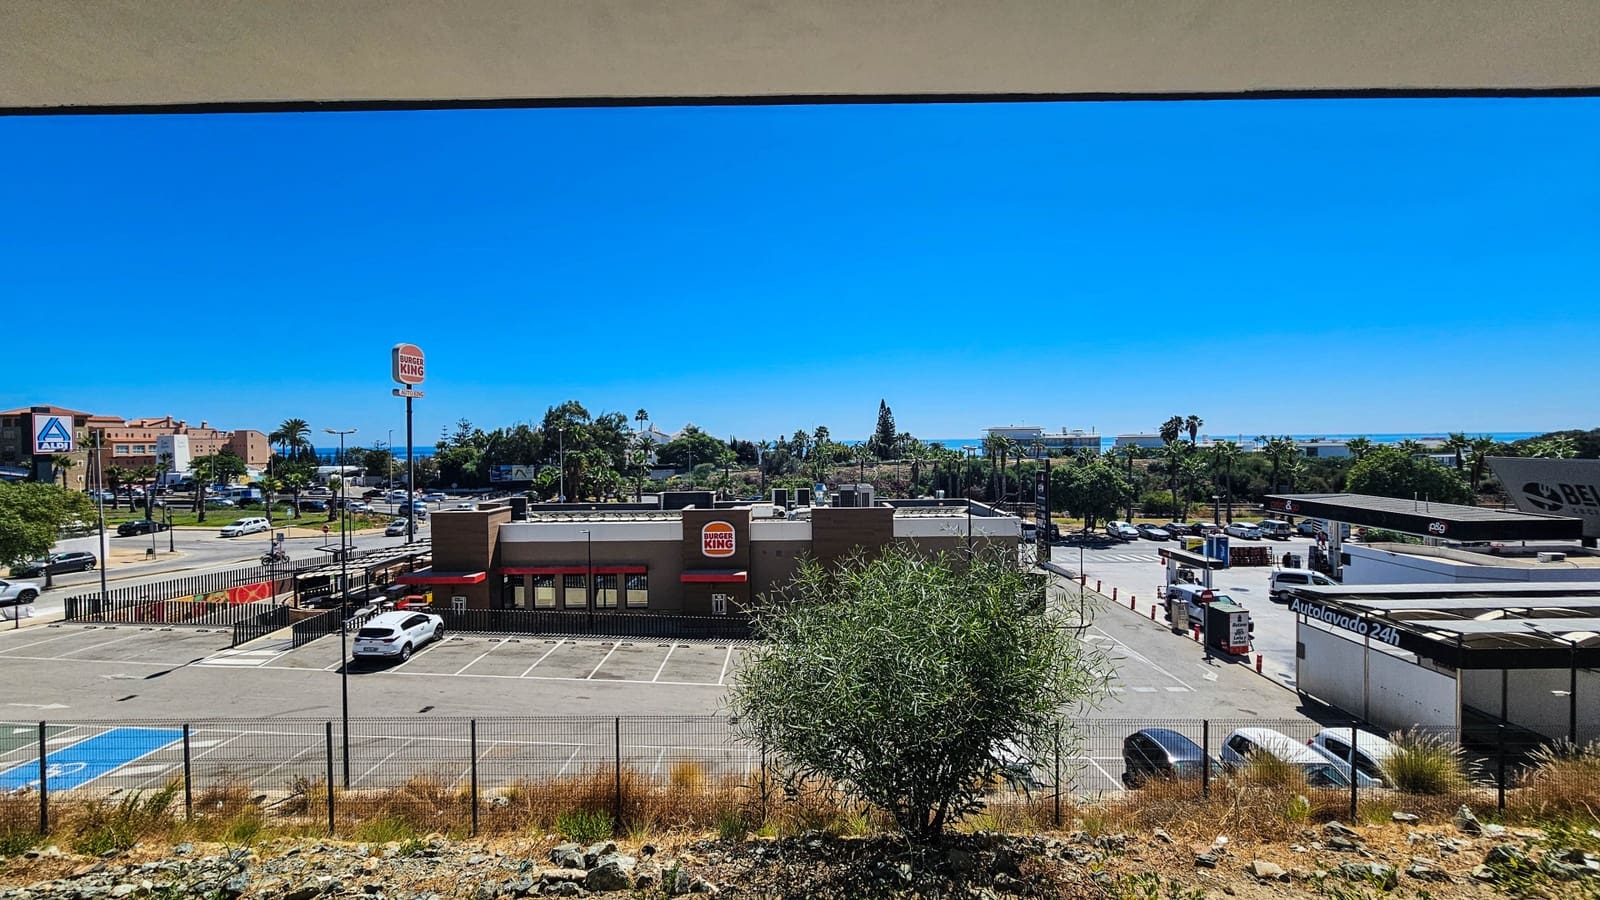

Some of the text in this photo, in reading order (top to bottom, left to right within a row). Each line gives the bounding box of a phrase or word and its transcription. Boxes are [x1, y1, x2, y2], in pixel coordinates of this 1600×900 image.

[400, 354, 424, 366] BURGER
[400, 363, 424, 376] KING
[41, 442, 69, 450] ALDI
[704, 532, 734, 540] BURGER
[704, 540, 734, 549] KING
[1291, 598, 1400, 646] Autolavado 24h
